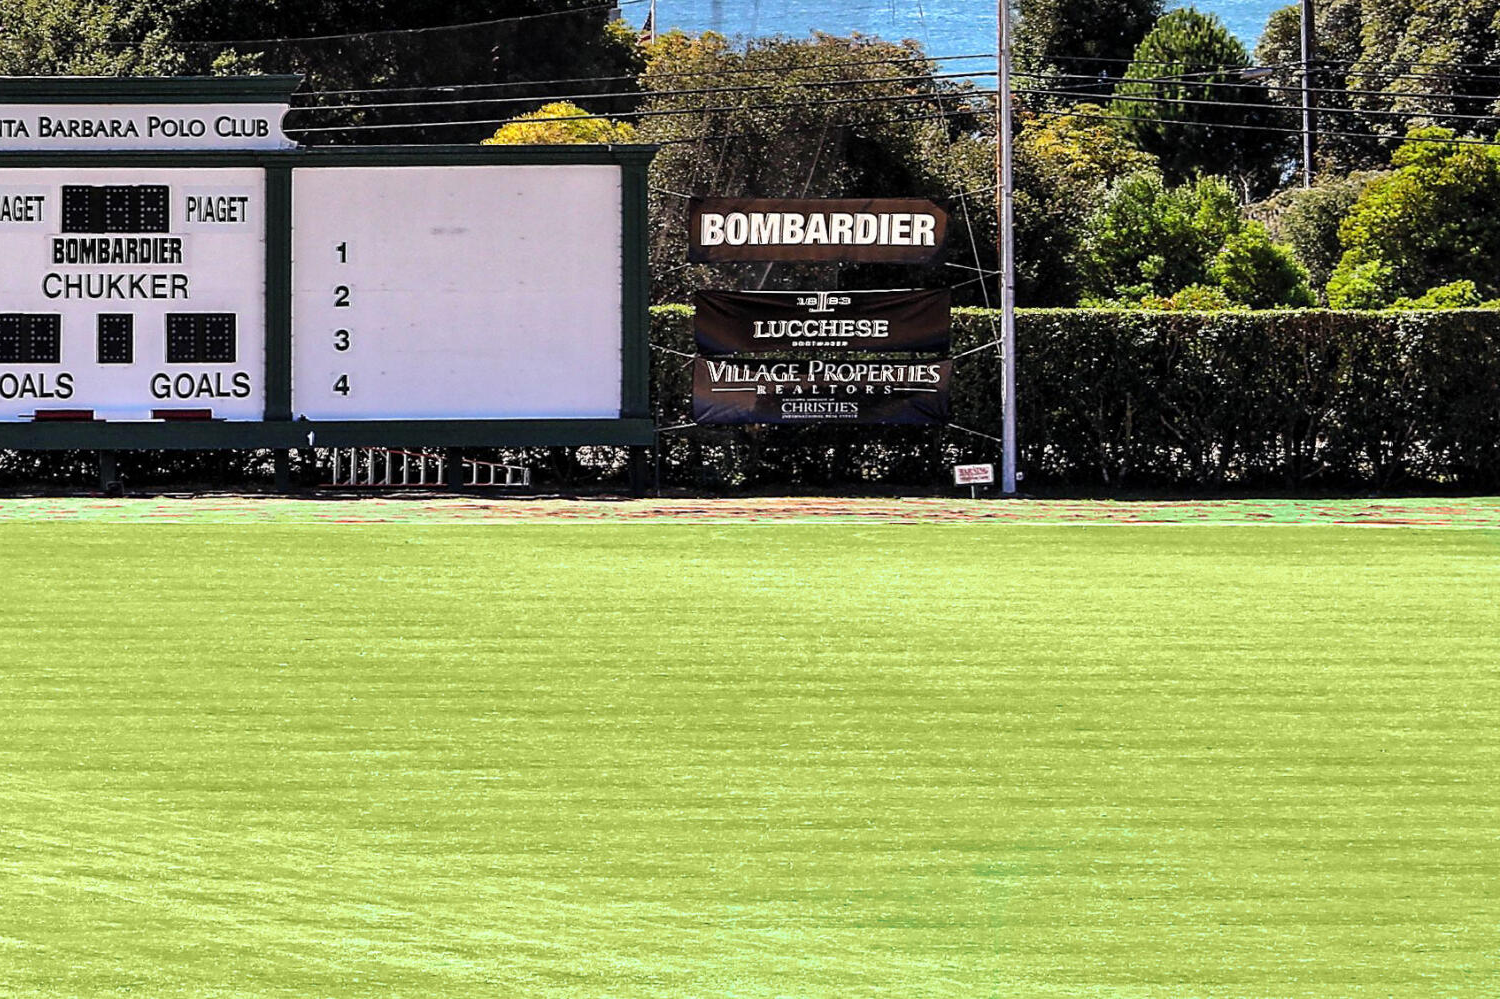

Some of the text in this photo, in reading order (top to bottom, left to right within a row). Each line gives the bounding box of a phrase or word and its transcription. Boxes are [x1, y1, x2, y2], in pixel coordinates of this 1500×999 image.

[187, 196, 249, 223] PIAGET
[701, 212, 937, 246] BOMBARDIER
[53, 237, 183, 264] BOMBARDIER
[335, 241, 348, 263] 1
[43, 272, 190, 299] CHUKKER
[334, 285, 350, 307] 2
[334, 329, 350, 352] 3
[753, 319, 889, 339] LUCCHESE
[150, 372, 251, 399] GOALS
[333, 374, 350, 396] 4
[756, 384, 891, 395] REALTORS
